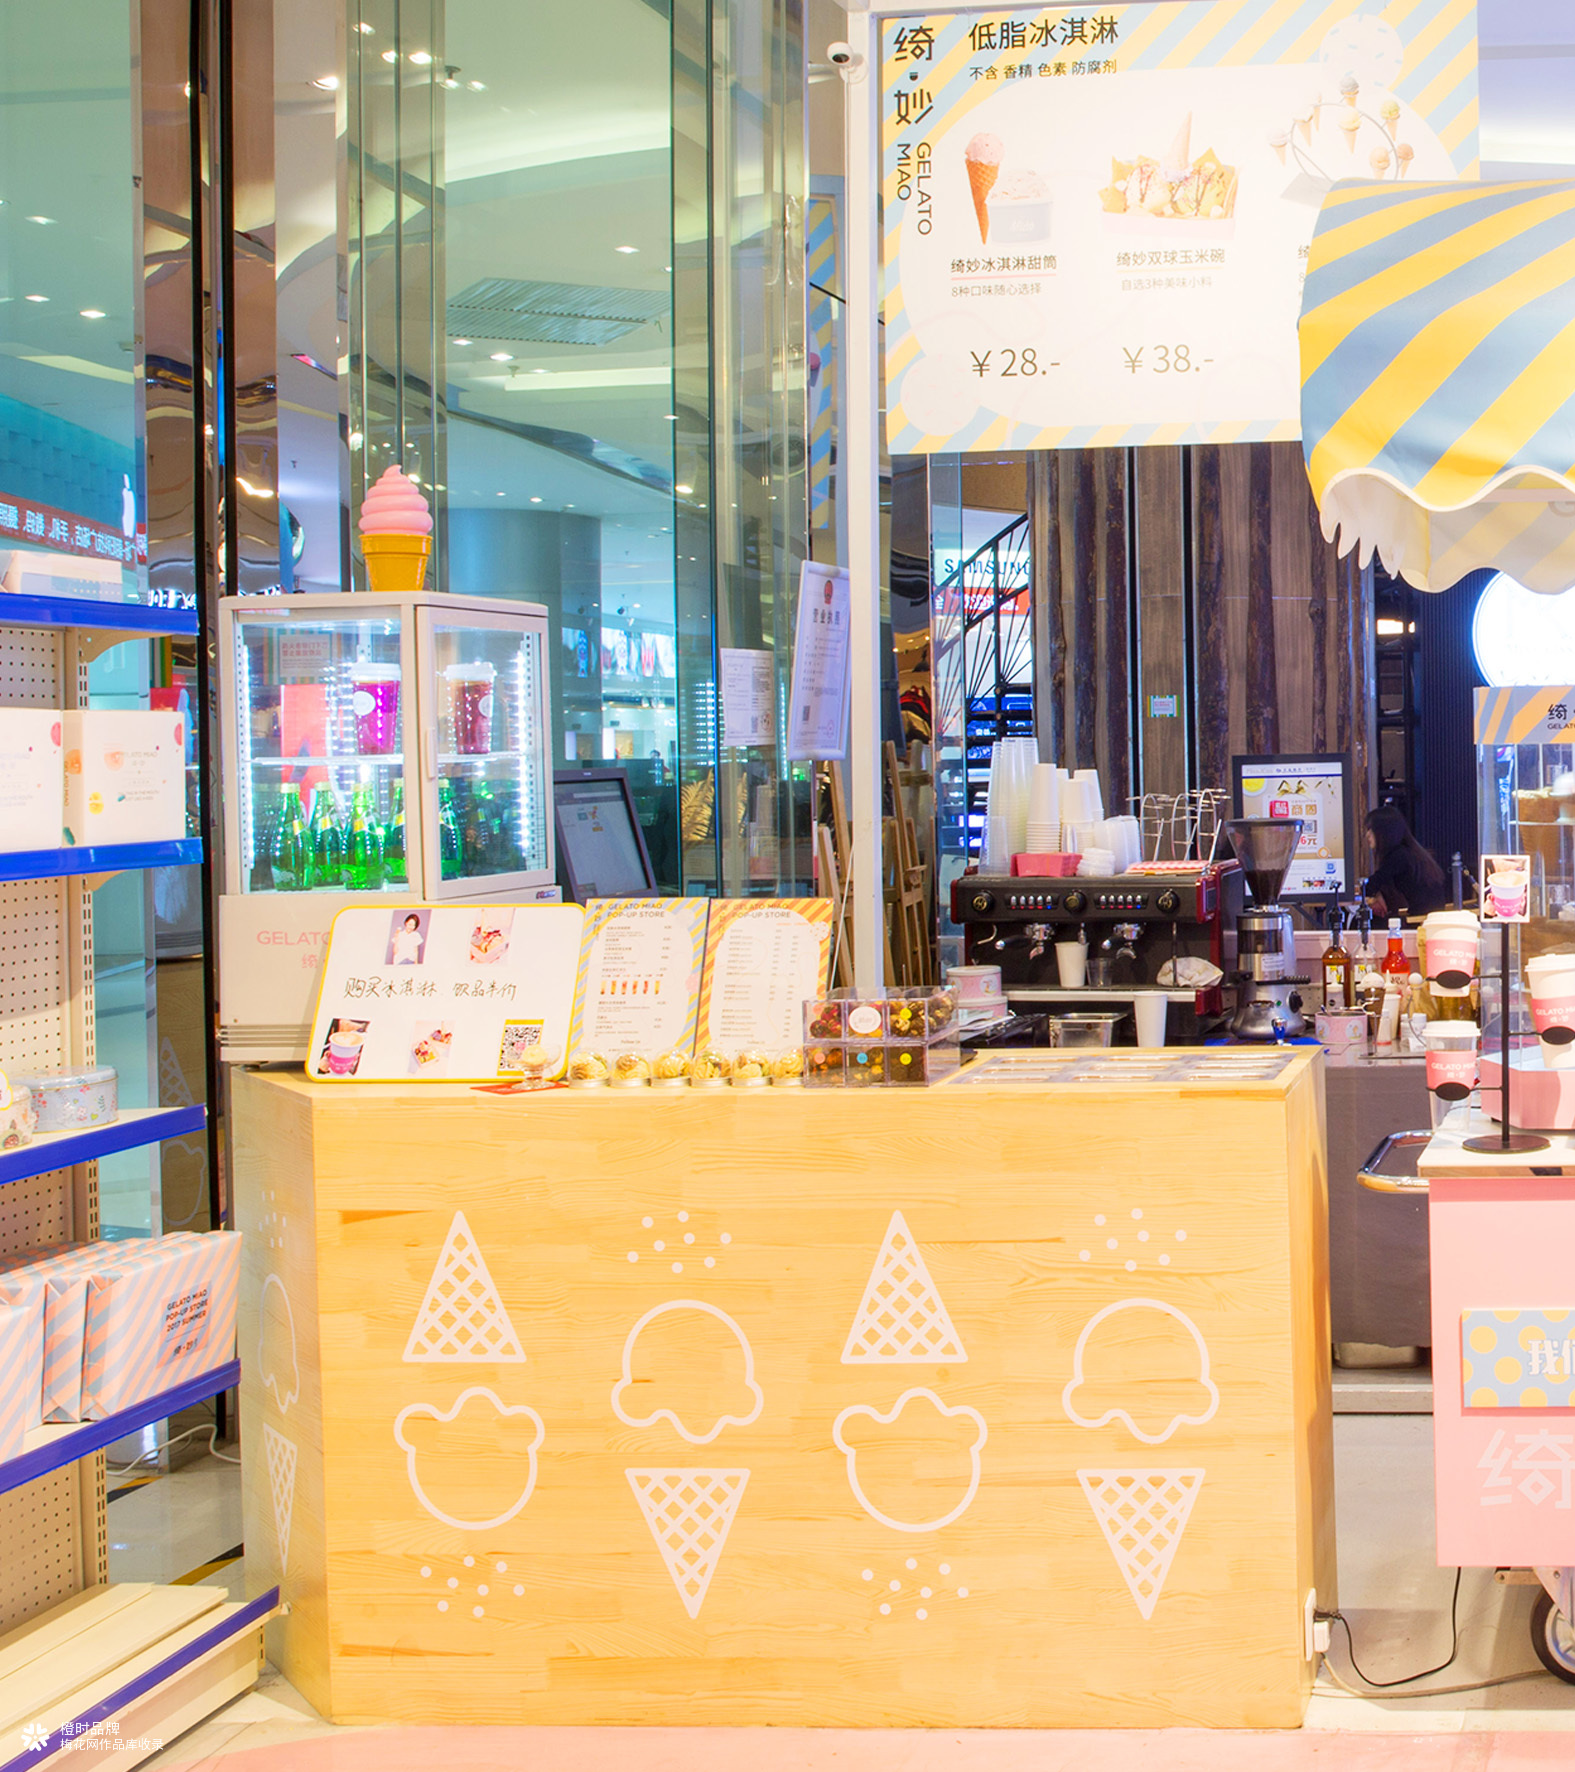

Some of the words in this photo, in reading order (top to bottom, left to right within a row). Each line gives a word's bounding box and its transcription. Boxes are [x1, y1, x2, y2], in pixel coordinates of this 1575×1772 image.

[968, 15, 1119, 51] 低脂冰淇淋
[969, 66, 999, 81] 不含
[1003, 63, 1033, 80] 香精
[1037, 62, 1067, 77] 色素
[1071, 58, 1118, 75] 防腐剂
[897, 143, 911, 201] MIAO
[917, 142, 932, 235] GELATO
[950, 255, 1058, 275] 绮妙冰淇淋甜筒
[1115, 248, 1226, 268] 绮妙双球玉米碗
[951, 283, 1042, 298] 8种口味随心选择
[607, 911, 634, 919] POP-UP
[636, 911, 665, 919] STORE
[608, 903, 640, 911] GELATO
[641, 902, 663, 910] MIAO
[731, 911, 760, 919] POP-UP
[761, 911, 791, 919] STORE
[732, 903, 766, 911] GELATO
[1433, 949, 1465, 959] GELATO
[343, 976, 438, 1000] 购买冰淇淋
[1536, 1007, 1564, 1016] GELATO
[1431, 1062, 1462, 1071] GELATO
[167, 1295, 191, 1311] GELATO
[192, 1289, 207, 1300] MIAO
[165, 1307, 188, 1322] POP-UP
[189, 1298, 208, 1312] STORE
[182, 1310, 207, 1326] SUMMER
